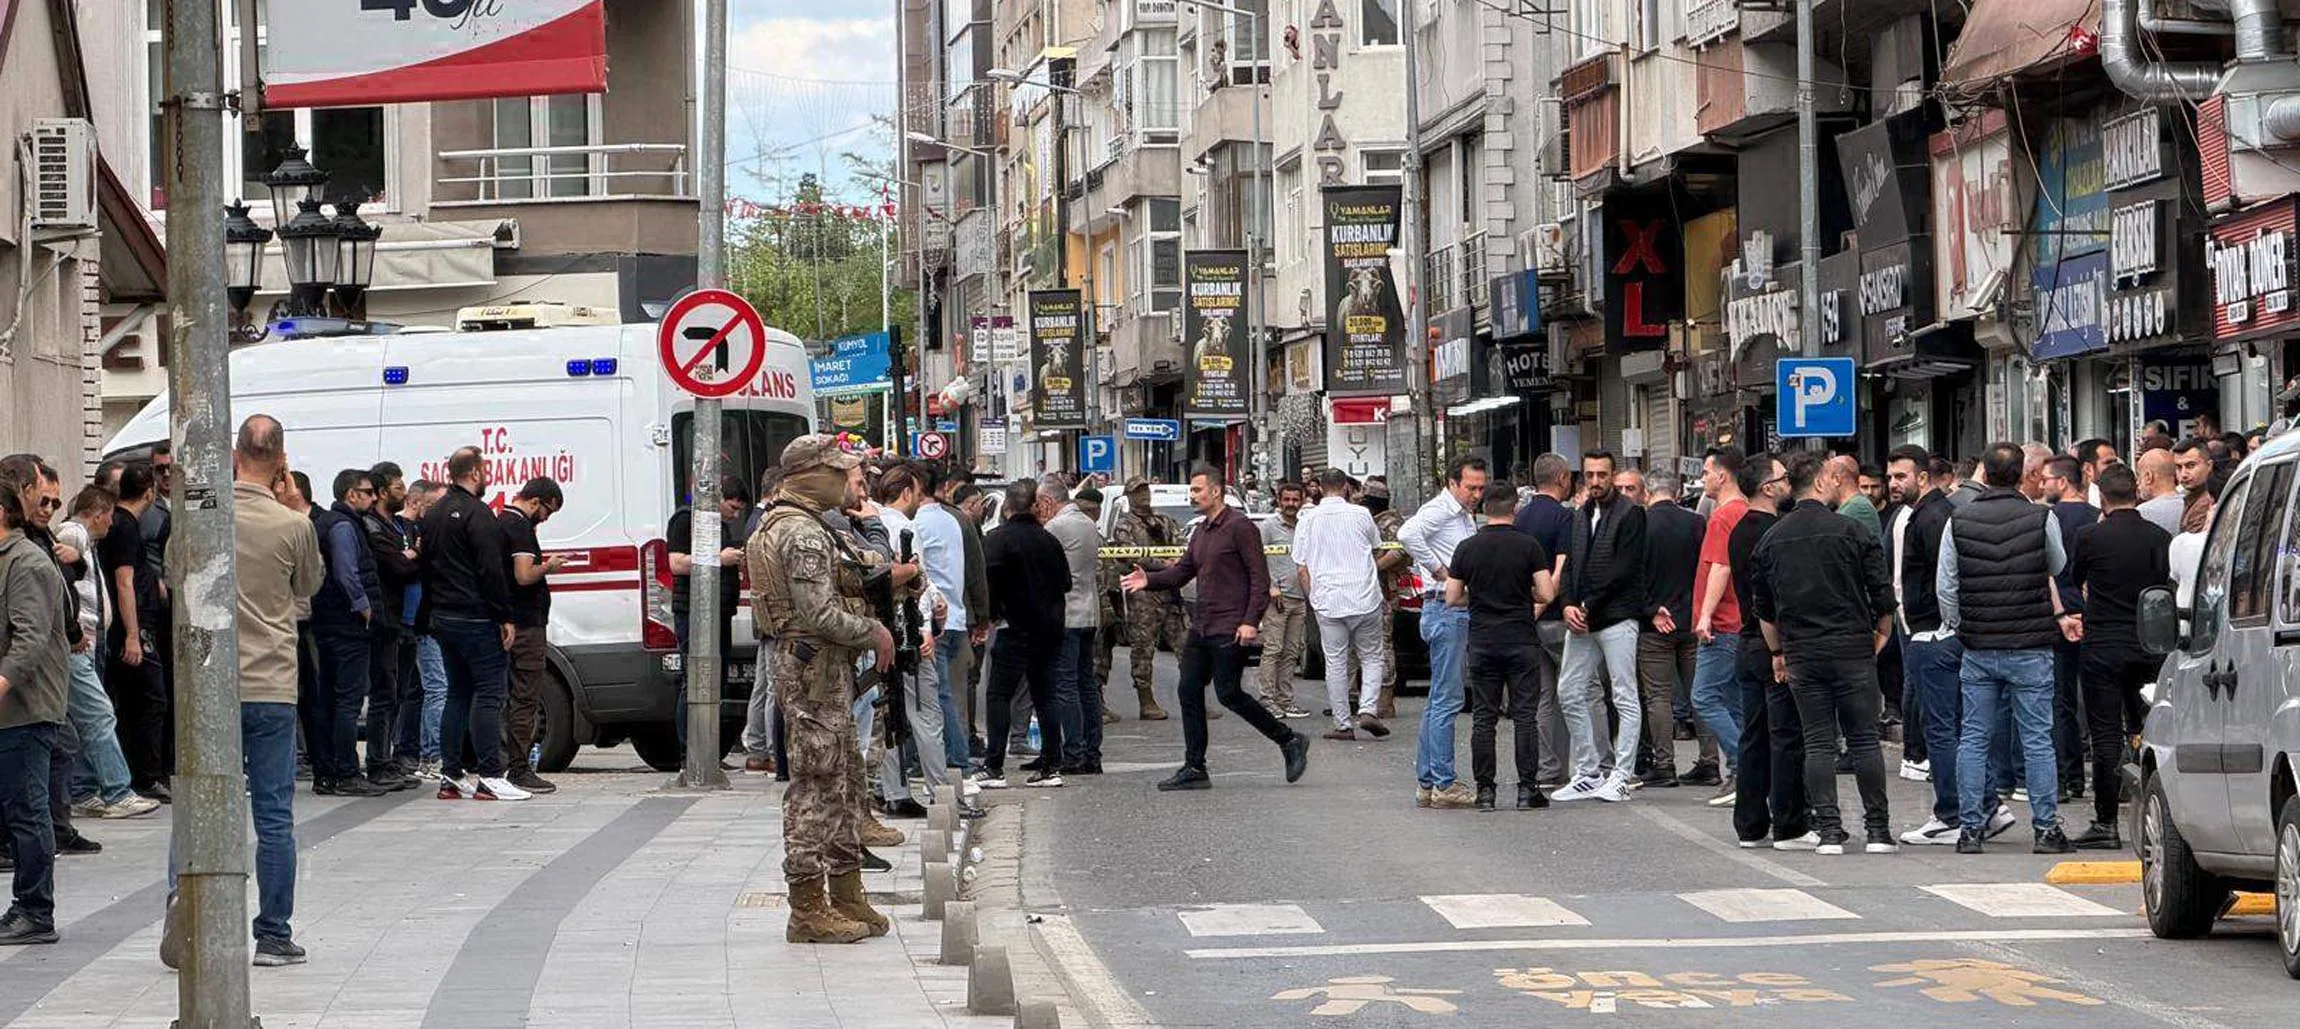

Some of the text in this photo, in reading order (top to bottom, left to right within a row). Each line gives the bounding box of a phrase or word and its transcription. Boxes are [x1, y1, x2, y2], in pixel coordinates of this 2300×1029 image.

[2249, 228, 2288, 296] DÖNER
[1191, 282, 1241, 296] KURBANLIK
[1506, 352, 1549, 376] HOTE
[1794, 366, 1836, 428] P
[482, 427, 513, 454] T.C.
[1088, 440, 1107, 469] P
[420, 459, 453, 484] SAĞ
